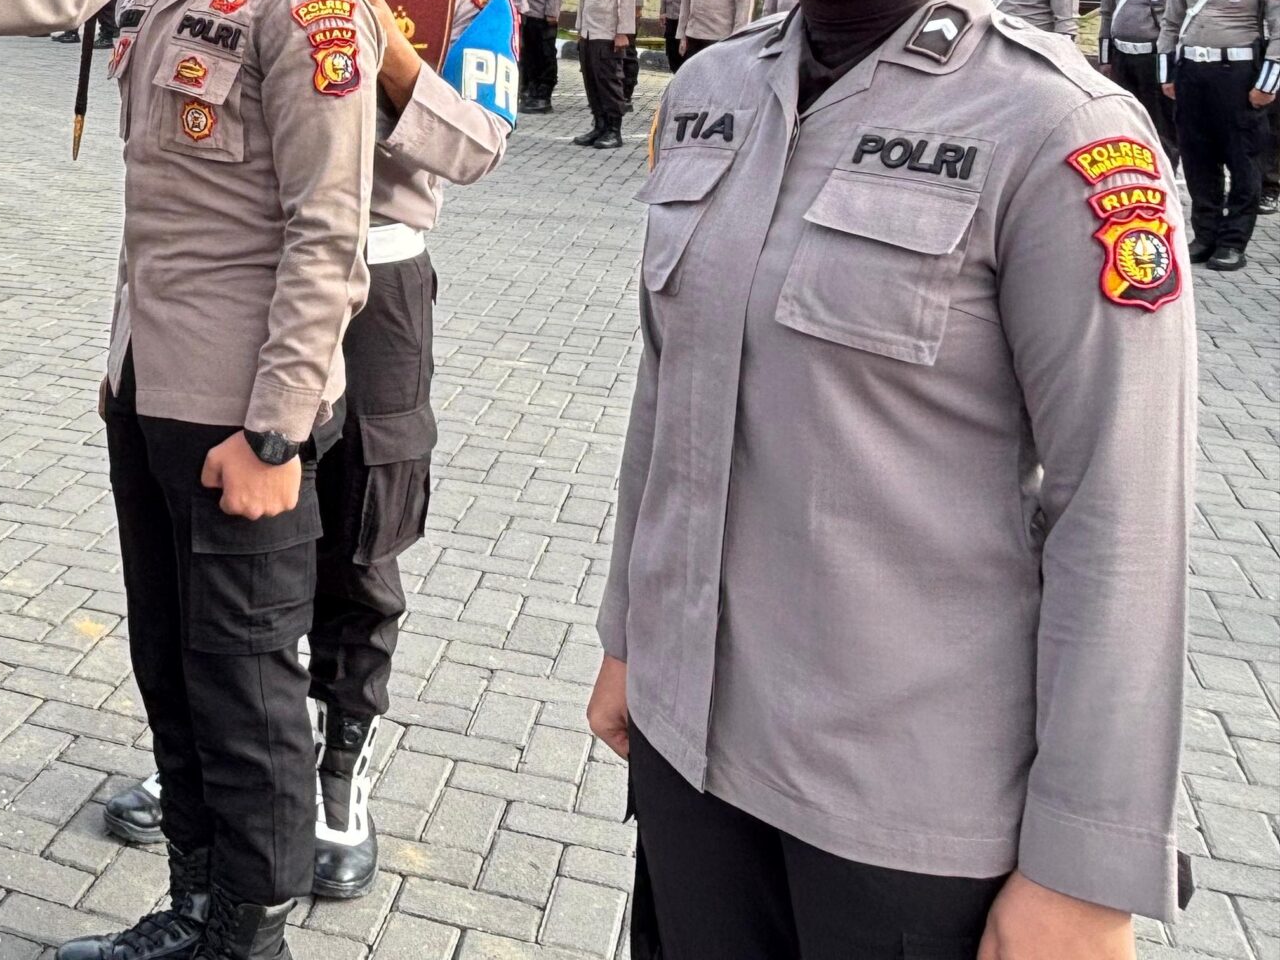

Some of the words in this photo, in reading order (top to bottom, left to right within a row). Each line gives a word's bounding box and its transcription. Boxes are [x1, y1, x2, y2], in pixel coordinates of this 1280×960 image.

[299, 0, 351, 21] POLRES
[177, 14, 242, 50] POLRI
[315, 29, 352, 42] RIAU
[674, 111, 733, 142] TIA
[852, 134, 977, 179] POLRI
[1077, 142, 1154, 170] POLRES
[1102, 190, 1161, 211] RIAU
